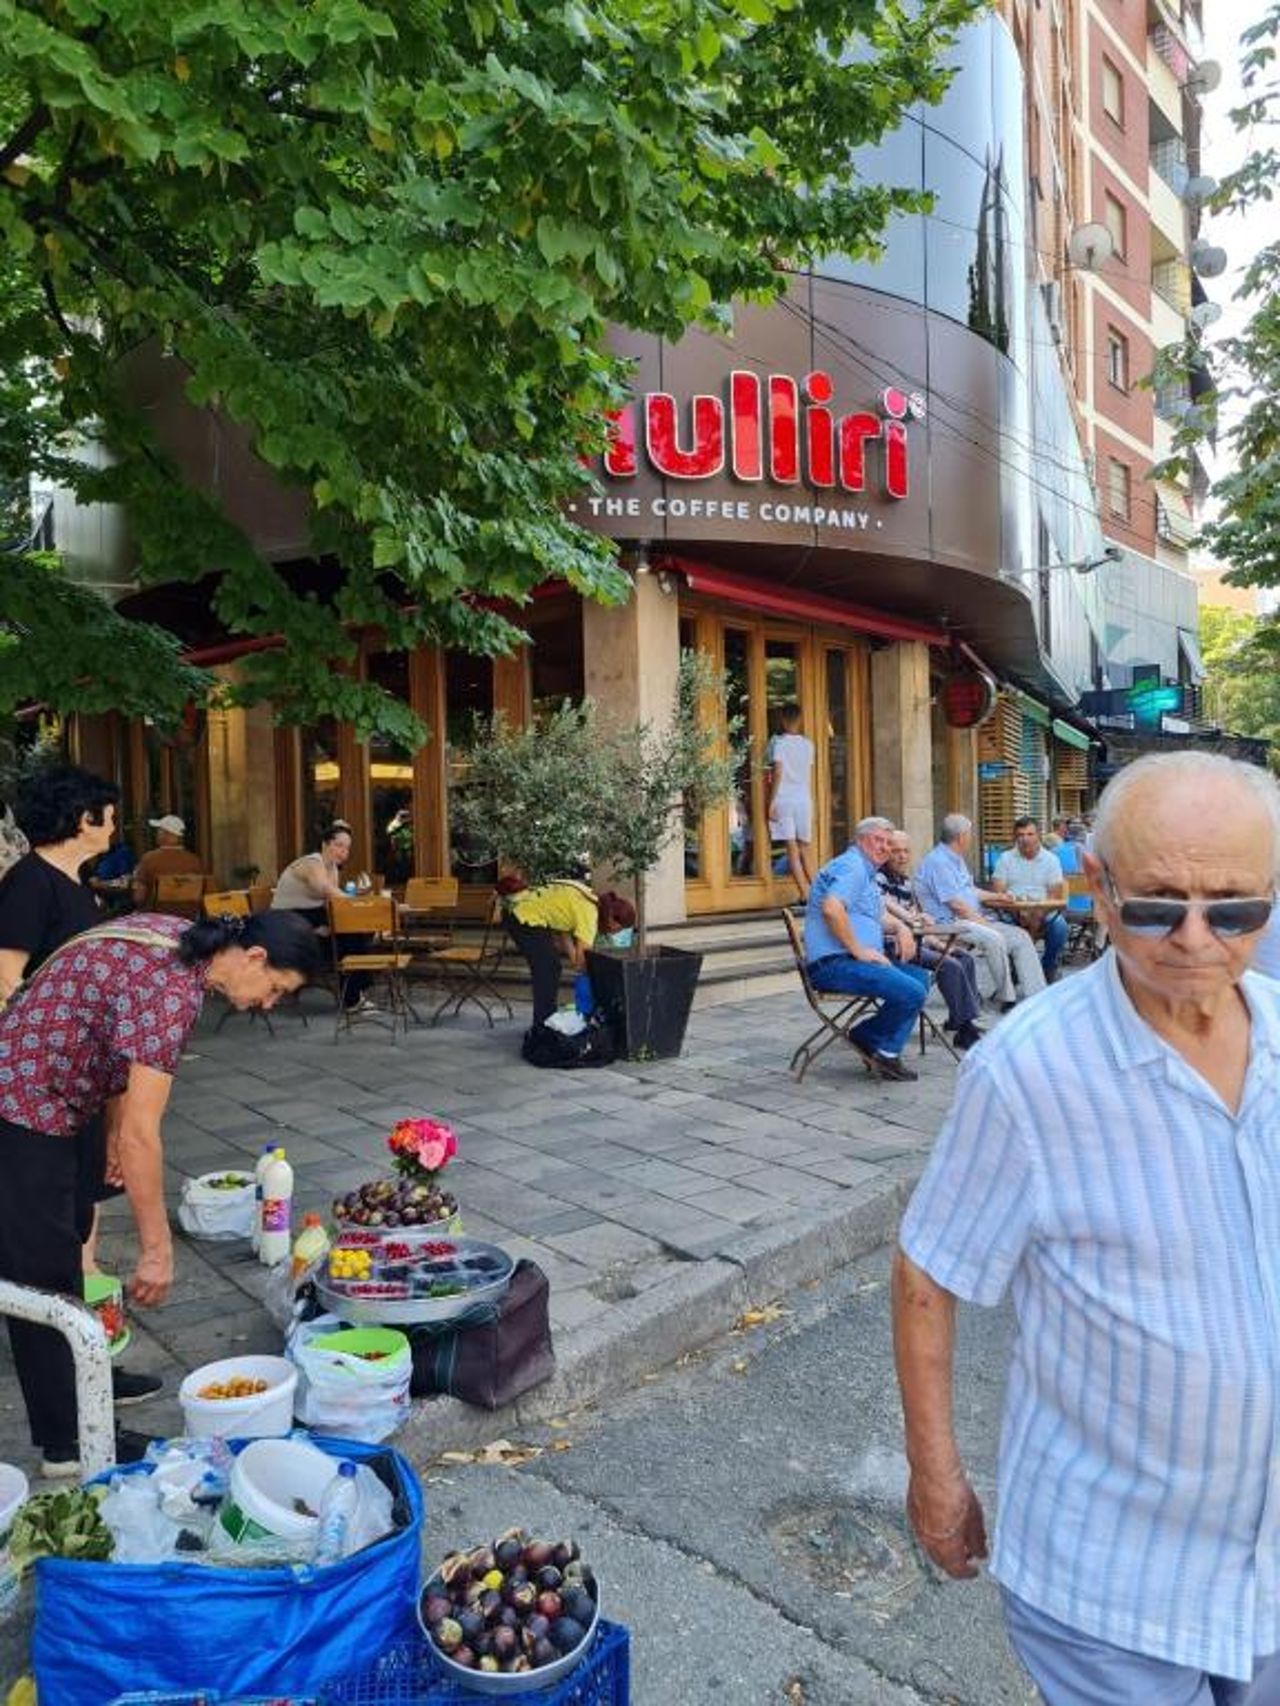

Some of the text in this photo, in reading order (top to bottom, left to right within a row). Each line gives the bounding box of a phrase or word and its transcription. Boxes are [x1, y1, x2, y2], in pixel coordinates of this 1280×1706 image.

[588, 497, 870, 530] THE COFFEE COMPANY
